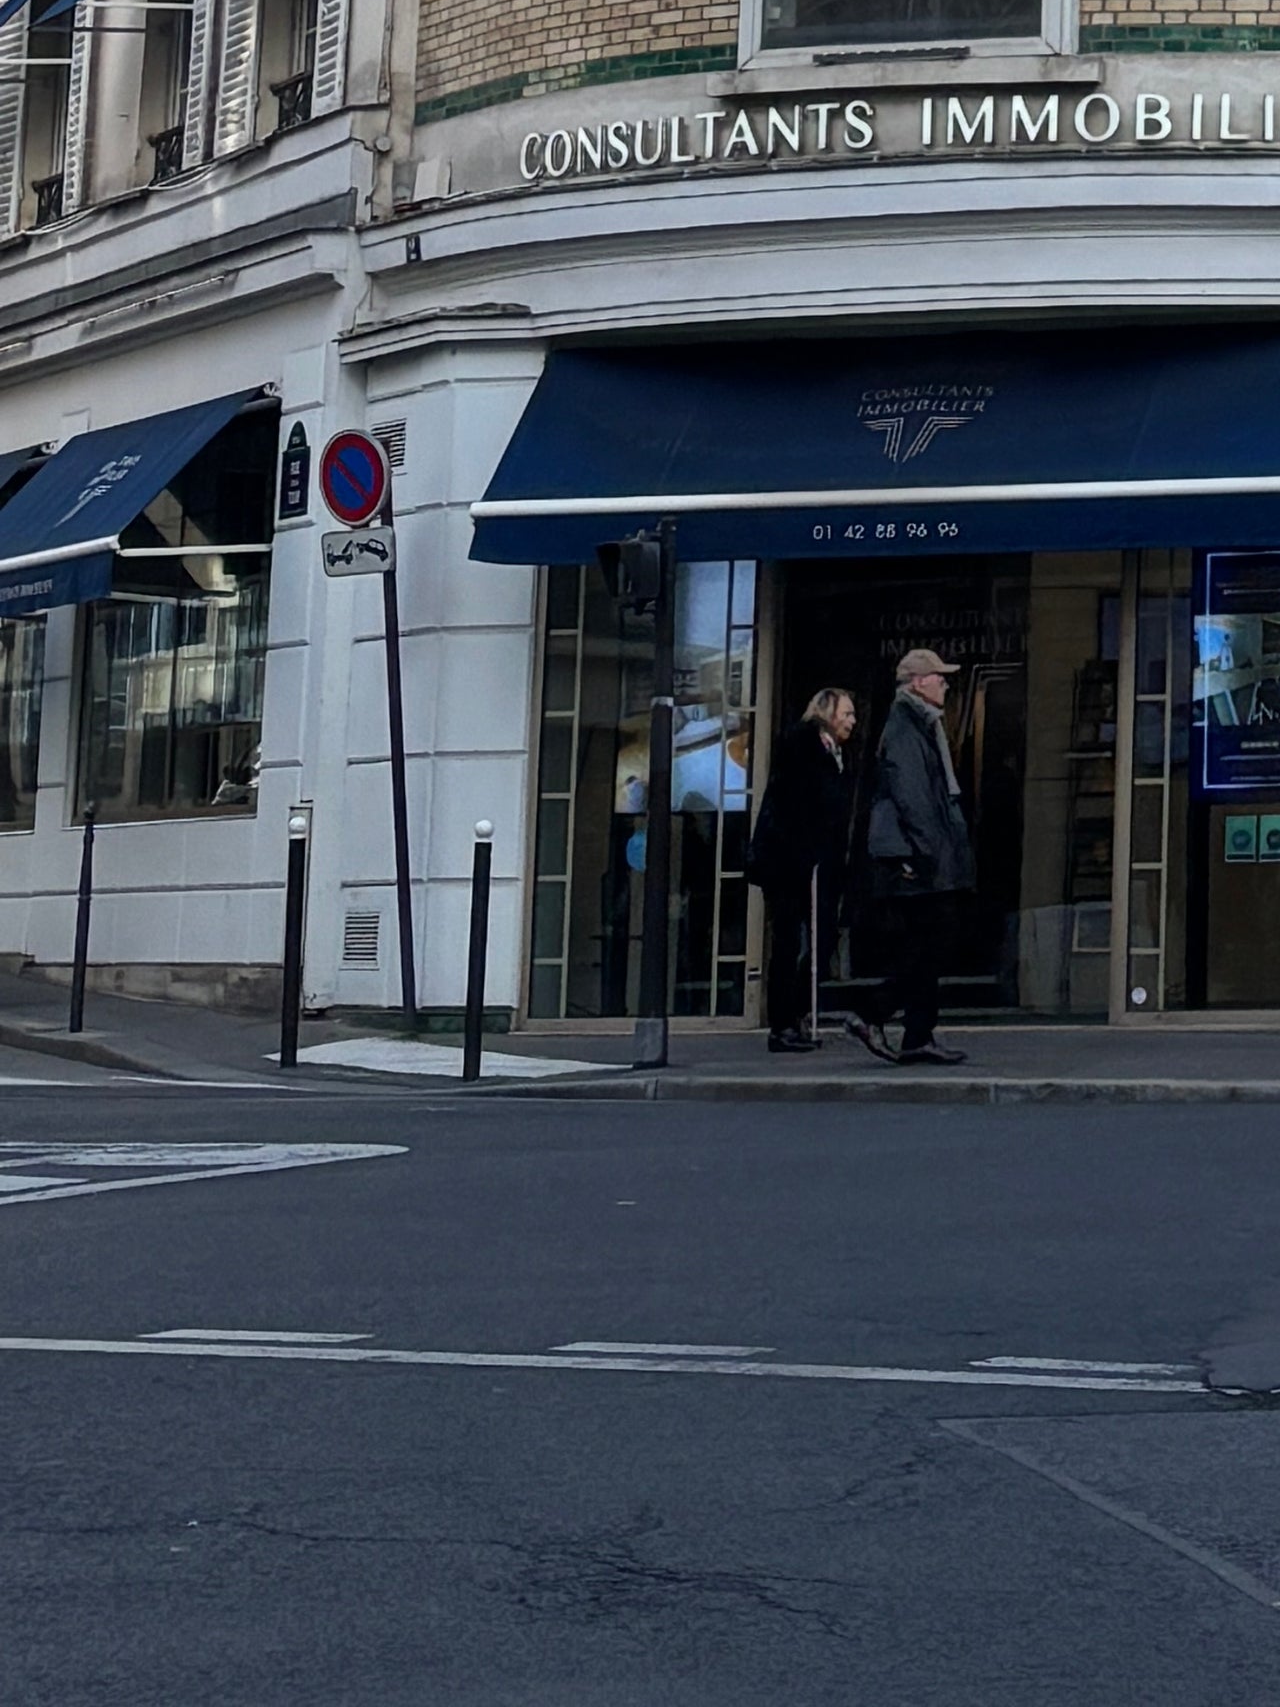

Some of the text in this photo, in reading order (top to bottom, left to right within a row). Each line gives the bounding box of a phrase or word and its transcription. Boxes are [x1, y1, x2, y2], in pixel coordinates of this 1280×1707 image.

[519, 100, 874, 180] CONSULTANTS
[862, 385, 993, 402] CONSULTANTS
[857, 399, 985, 417] IMMOBILIER
[813, 522, 958, 539] 01 42 88 96 96
